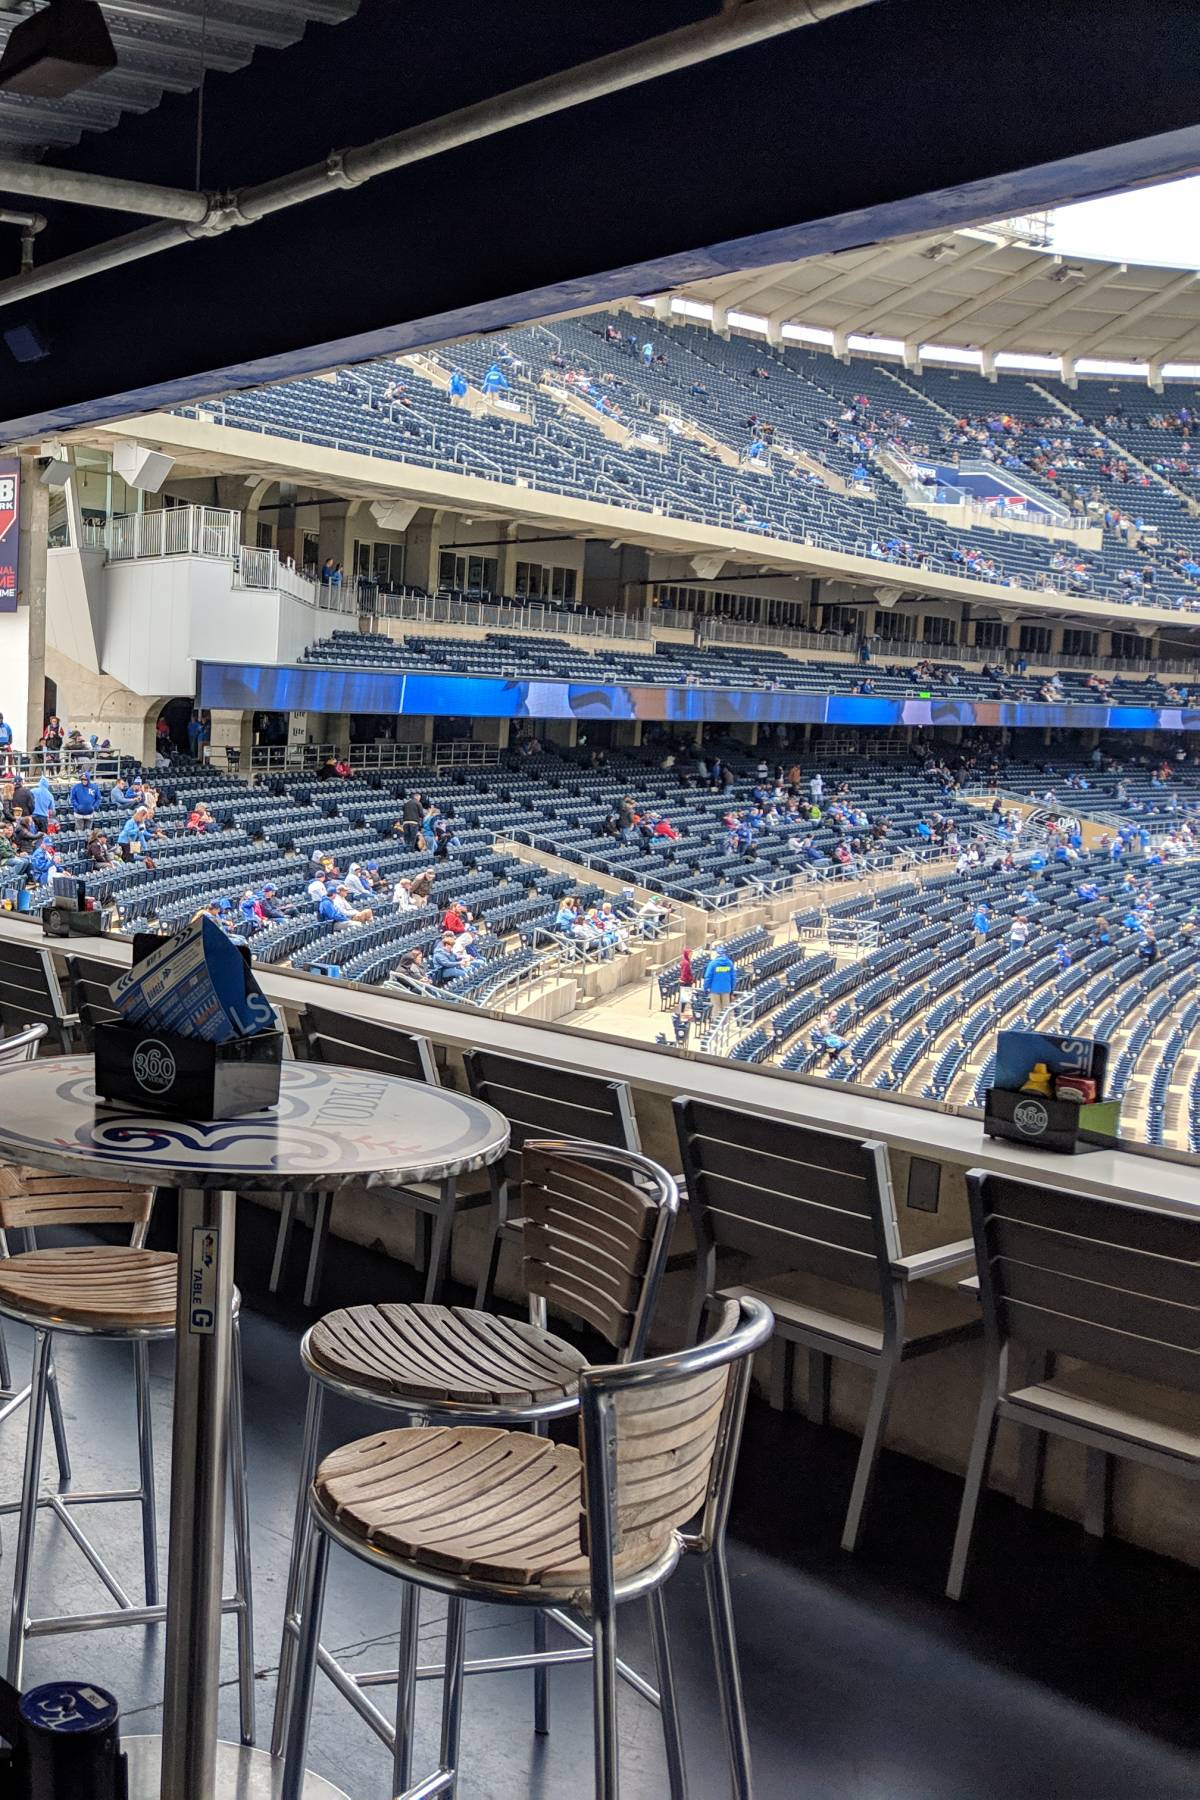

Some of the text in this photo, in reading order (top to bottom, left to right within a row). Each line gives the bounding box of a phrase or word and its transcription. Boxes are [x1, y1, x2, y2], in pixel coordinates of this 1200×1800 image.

[292, 727, 305, 737] Lite
[135, 1049, 175, 1080] 360
[310, 1081, 389, 1127] VODKA
[1015, 1106, 1048, 1126] 360
[192, 1268, 213, 1328] TABLE G
